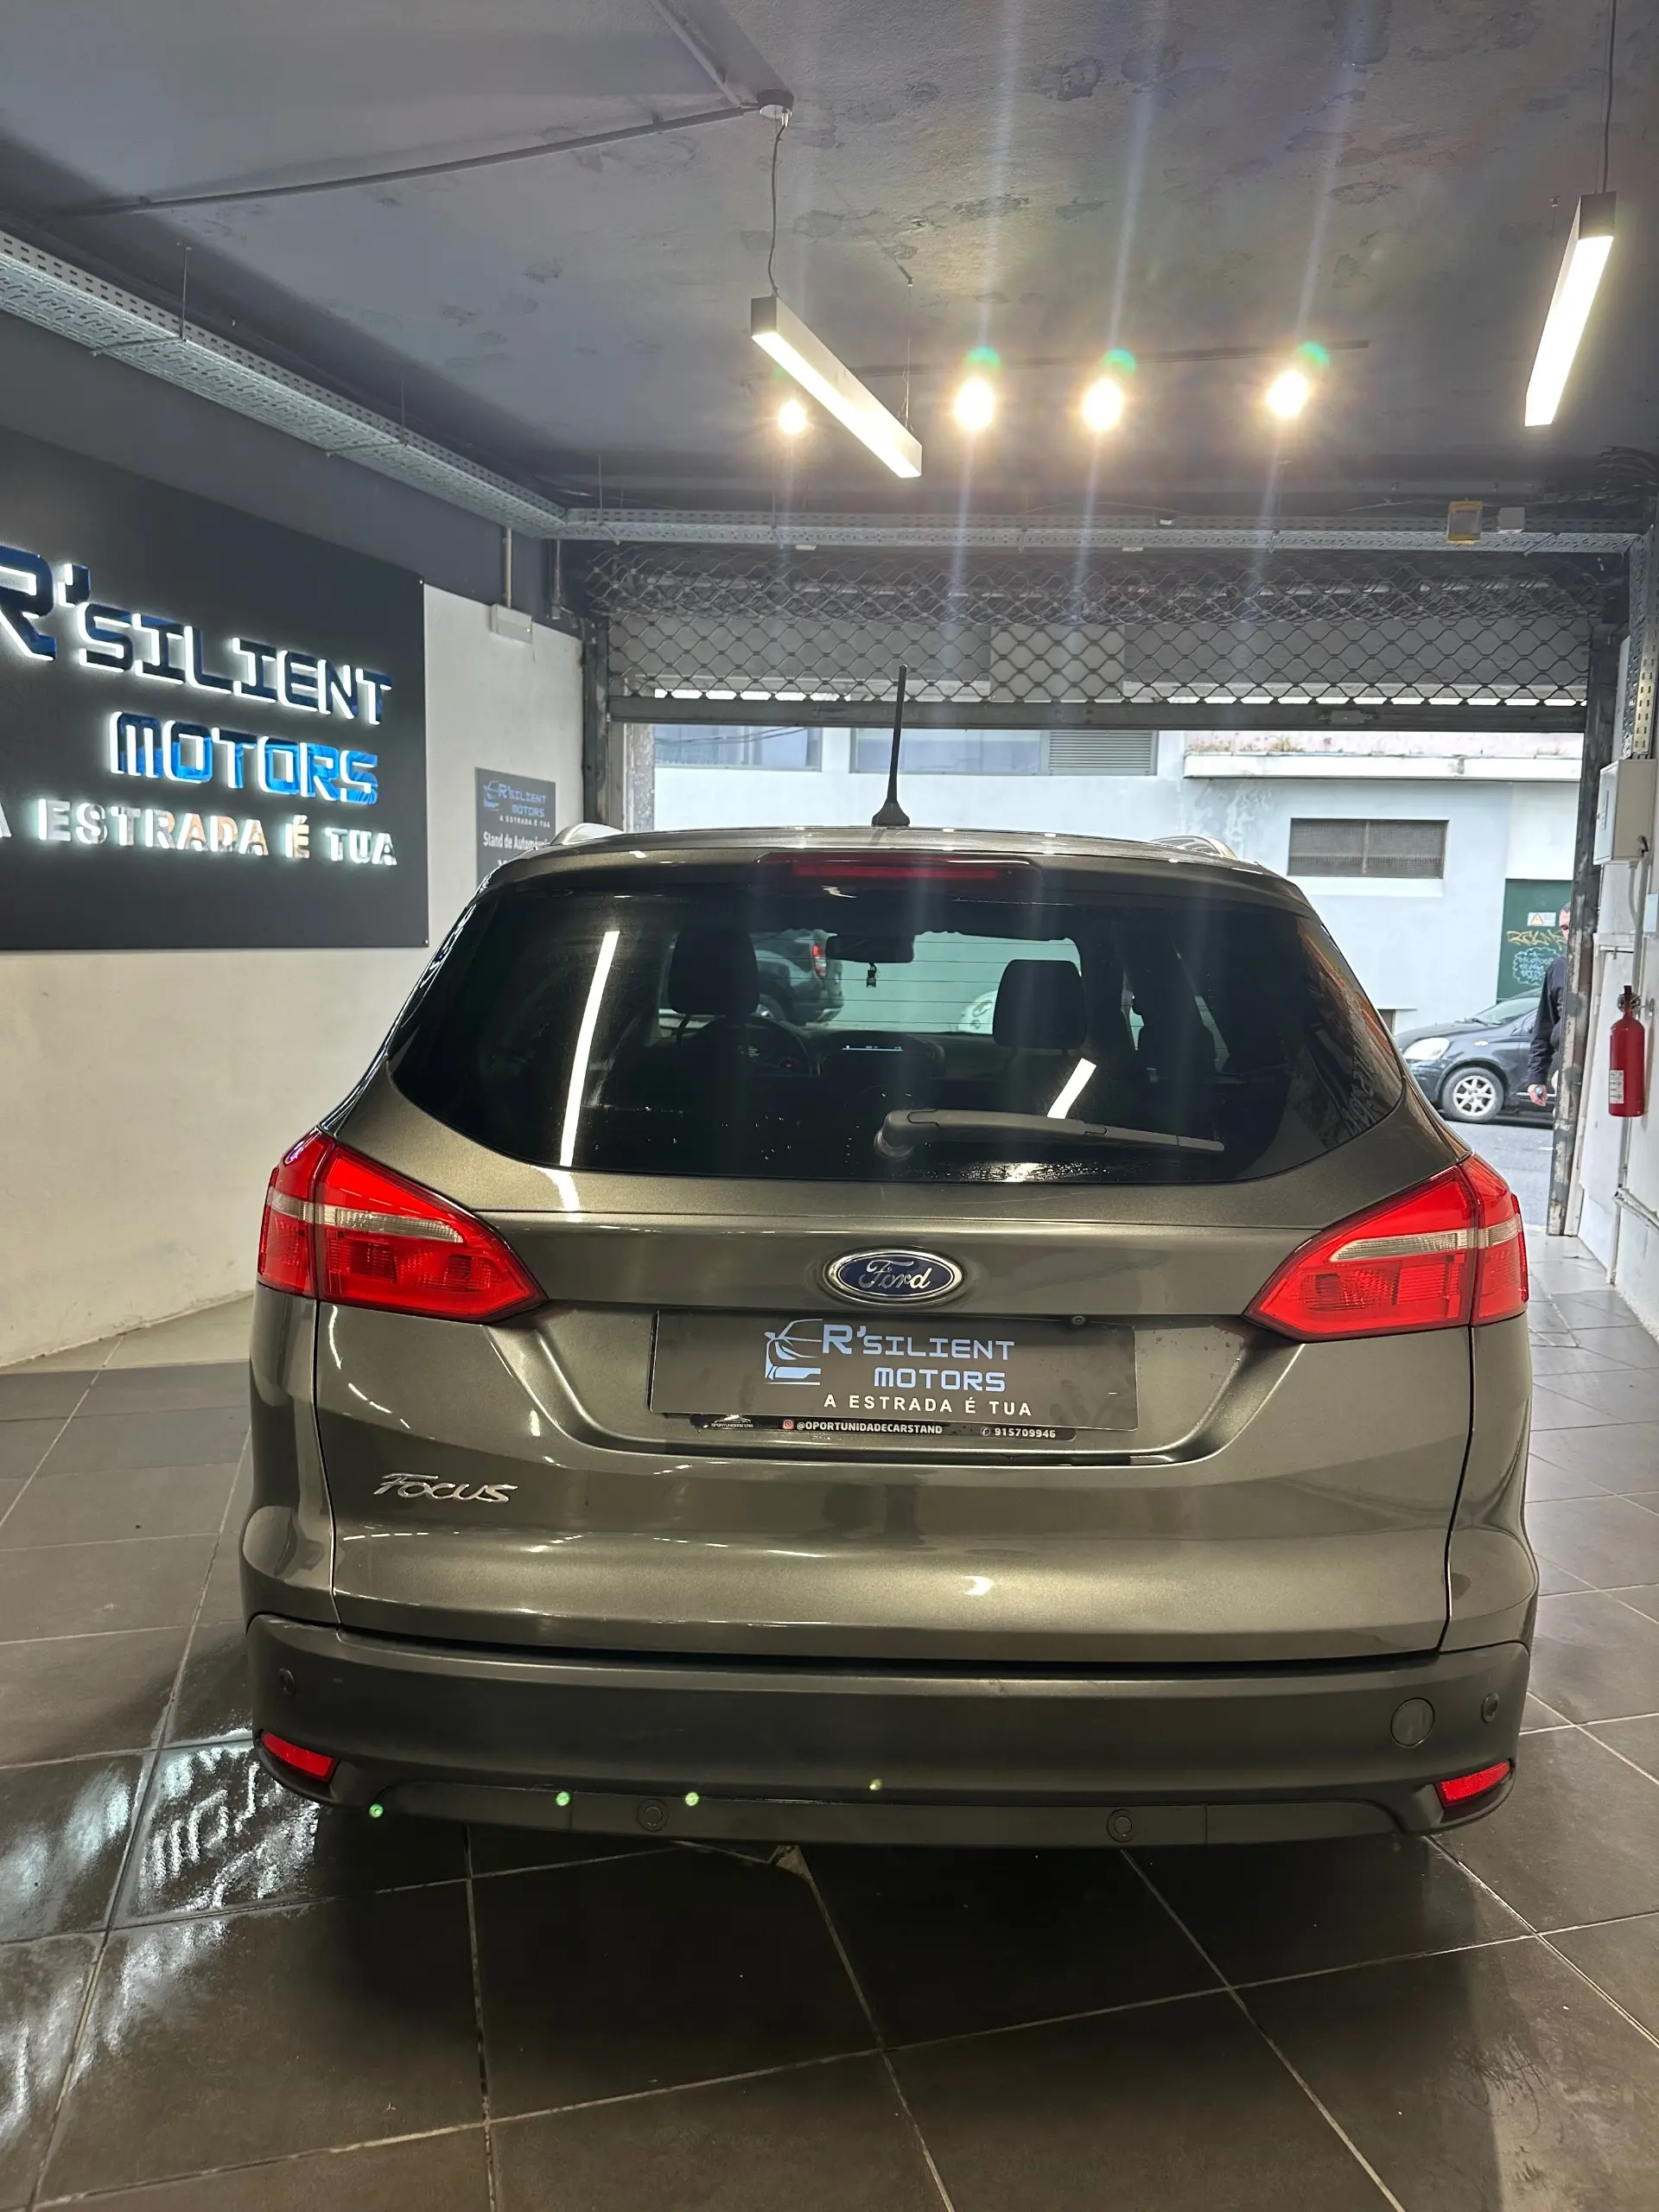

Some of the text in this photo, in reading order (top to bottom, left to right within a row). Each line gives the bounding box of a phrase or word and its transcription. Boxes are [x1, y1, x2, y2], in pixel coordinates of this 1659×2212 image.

[0, 544, 392, 725] R'SILIENT
[109, 711, 378, 804] MOTORS
[512, 804, 545, 817] MOTORS
[38, 798, 270, 856] ESTRADA
[284, 814, 310, 859] É
[325, 827, 397, 866] TUA
[483, 830, 504, 848] Stand
[504, 834, 512, 849] de
[858, 1259, 933, 1289] Ford
[822, 1324, 1015, 1361] R'SILIENT
[874, 1367, 1006, 1392] MOTORS
[823, 1394, 1032, 1416] A ESTRADA É TUA
[797, 1421, 943, 1434] @OPORTUNIDADECARSTAND
[994, 1427, 1056, 1439] 915709946
